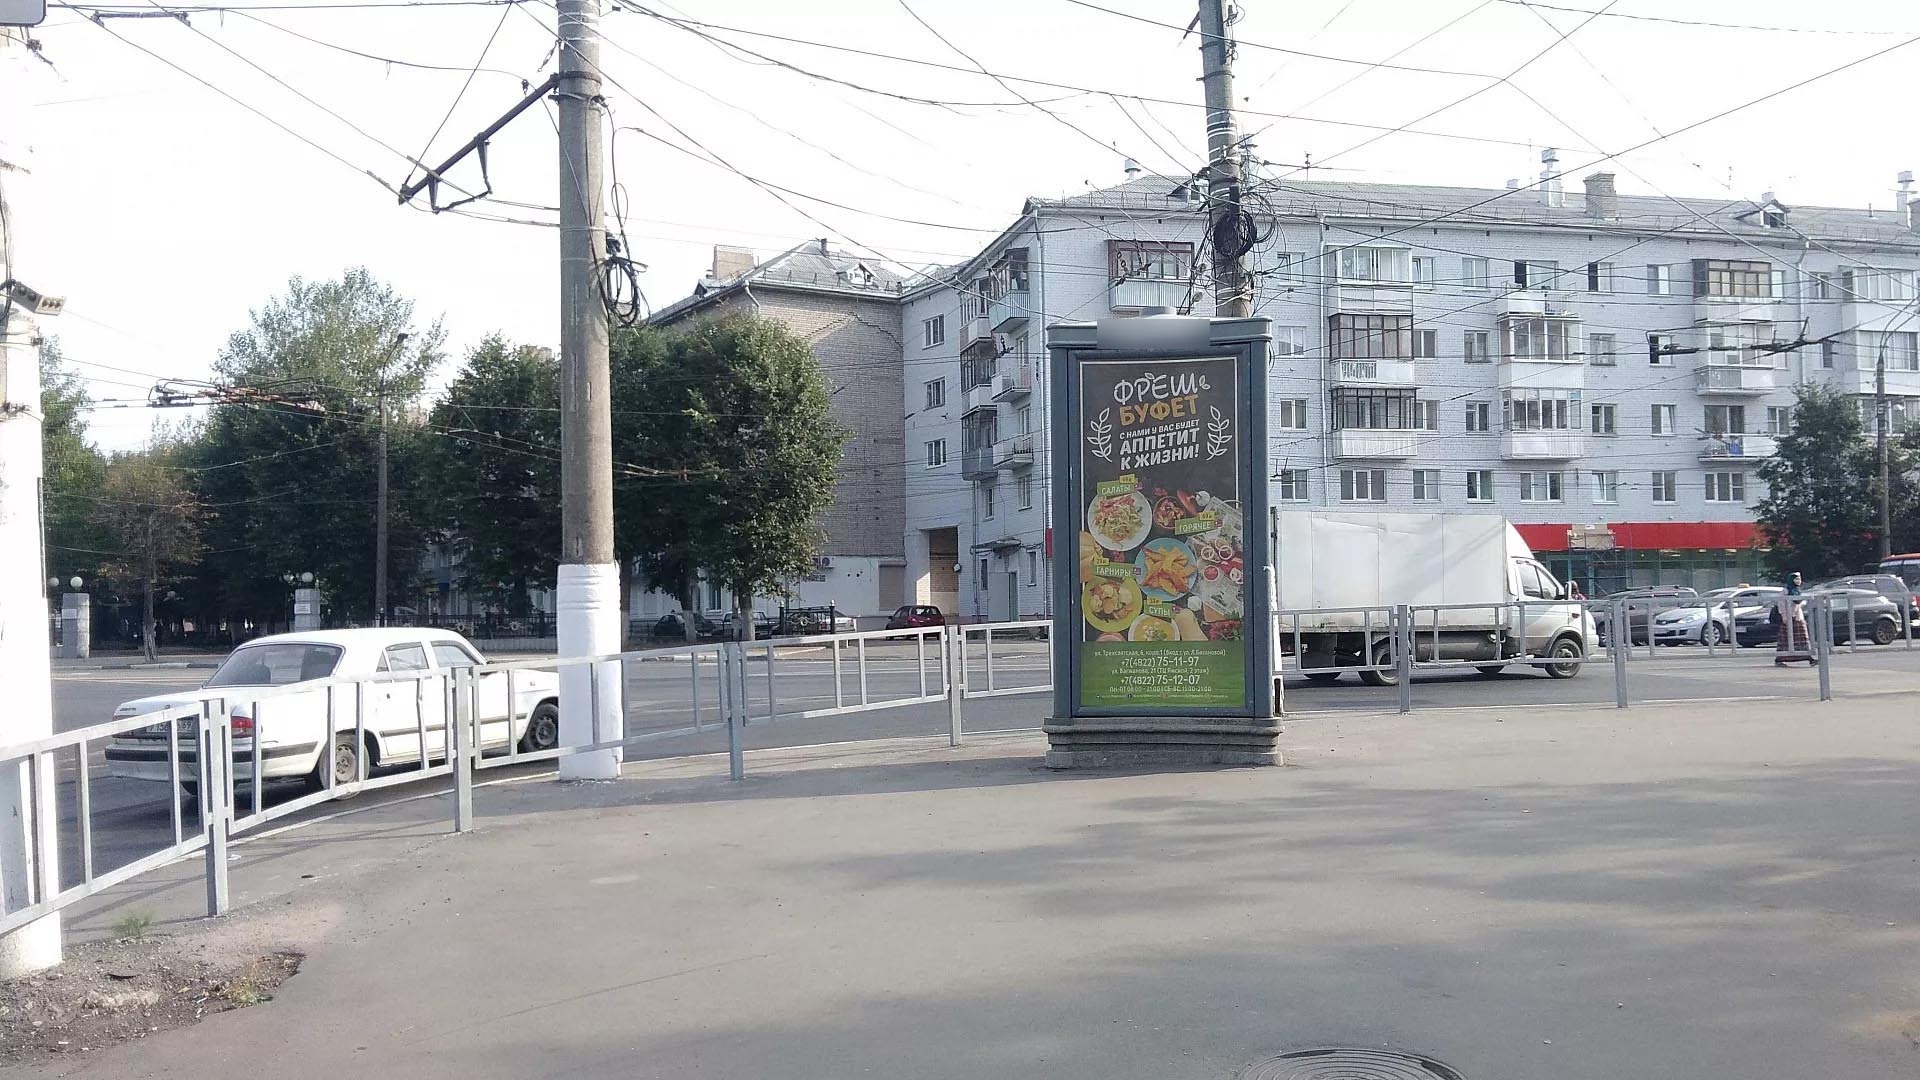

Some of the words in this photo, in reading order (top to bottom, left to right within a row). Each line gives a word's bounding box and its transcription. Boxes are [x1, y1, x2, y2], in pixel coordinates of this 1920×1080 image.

[1113, 372, 1198, 405] ФРЕШ
[1119, 394, 1199, 426] БУФЕТ
[1119, 432, 1125, 440] С
[1126, 428, 1151, 438] НАМИ
[1151, 426, 1157, 435] У
[1158, 424, 1174, 433] ВАС
[1175, 419, 1200, 430] БУДЕТ
[1119, 428, 1200, 455] АППЕТИТ
[1120, 457, 1131, 470] К
[1134, 444, 1200, 469] ЖИЗНИ!
[1101, 485, 1131, 495] САЛАТЫ
[1179, 521, 1211, 533] ГОРЯЧЕЕ
[1096, 566, 1131, 577] ГАРНИРЫ
[1149, 605, 1170, 616] СУПЫ
[1121, 657, 1155, 668] +7(4822)
[1157, 656, 1200, 667] 75-11-97
[1121, 675, 1155, 686] +7(4822)
[1157, 674, 1201, 685] 75-12-07
